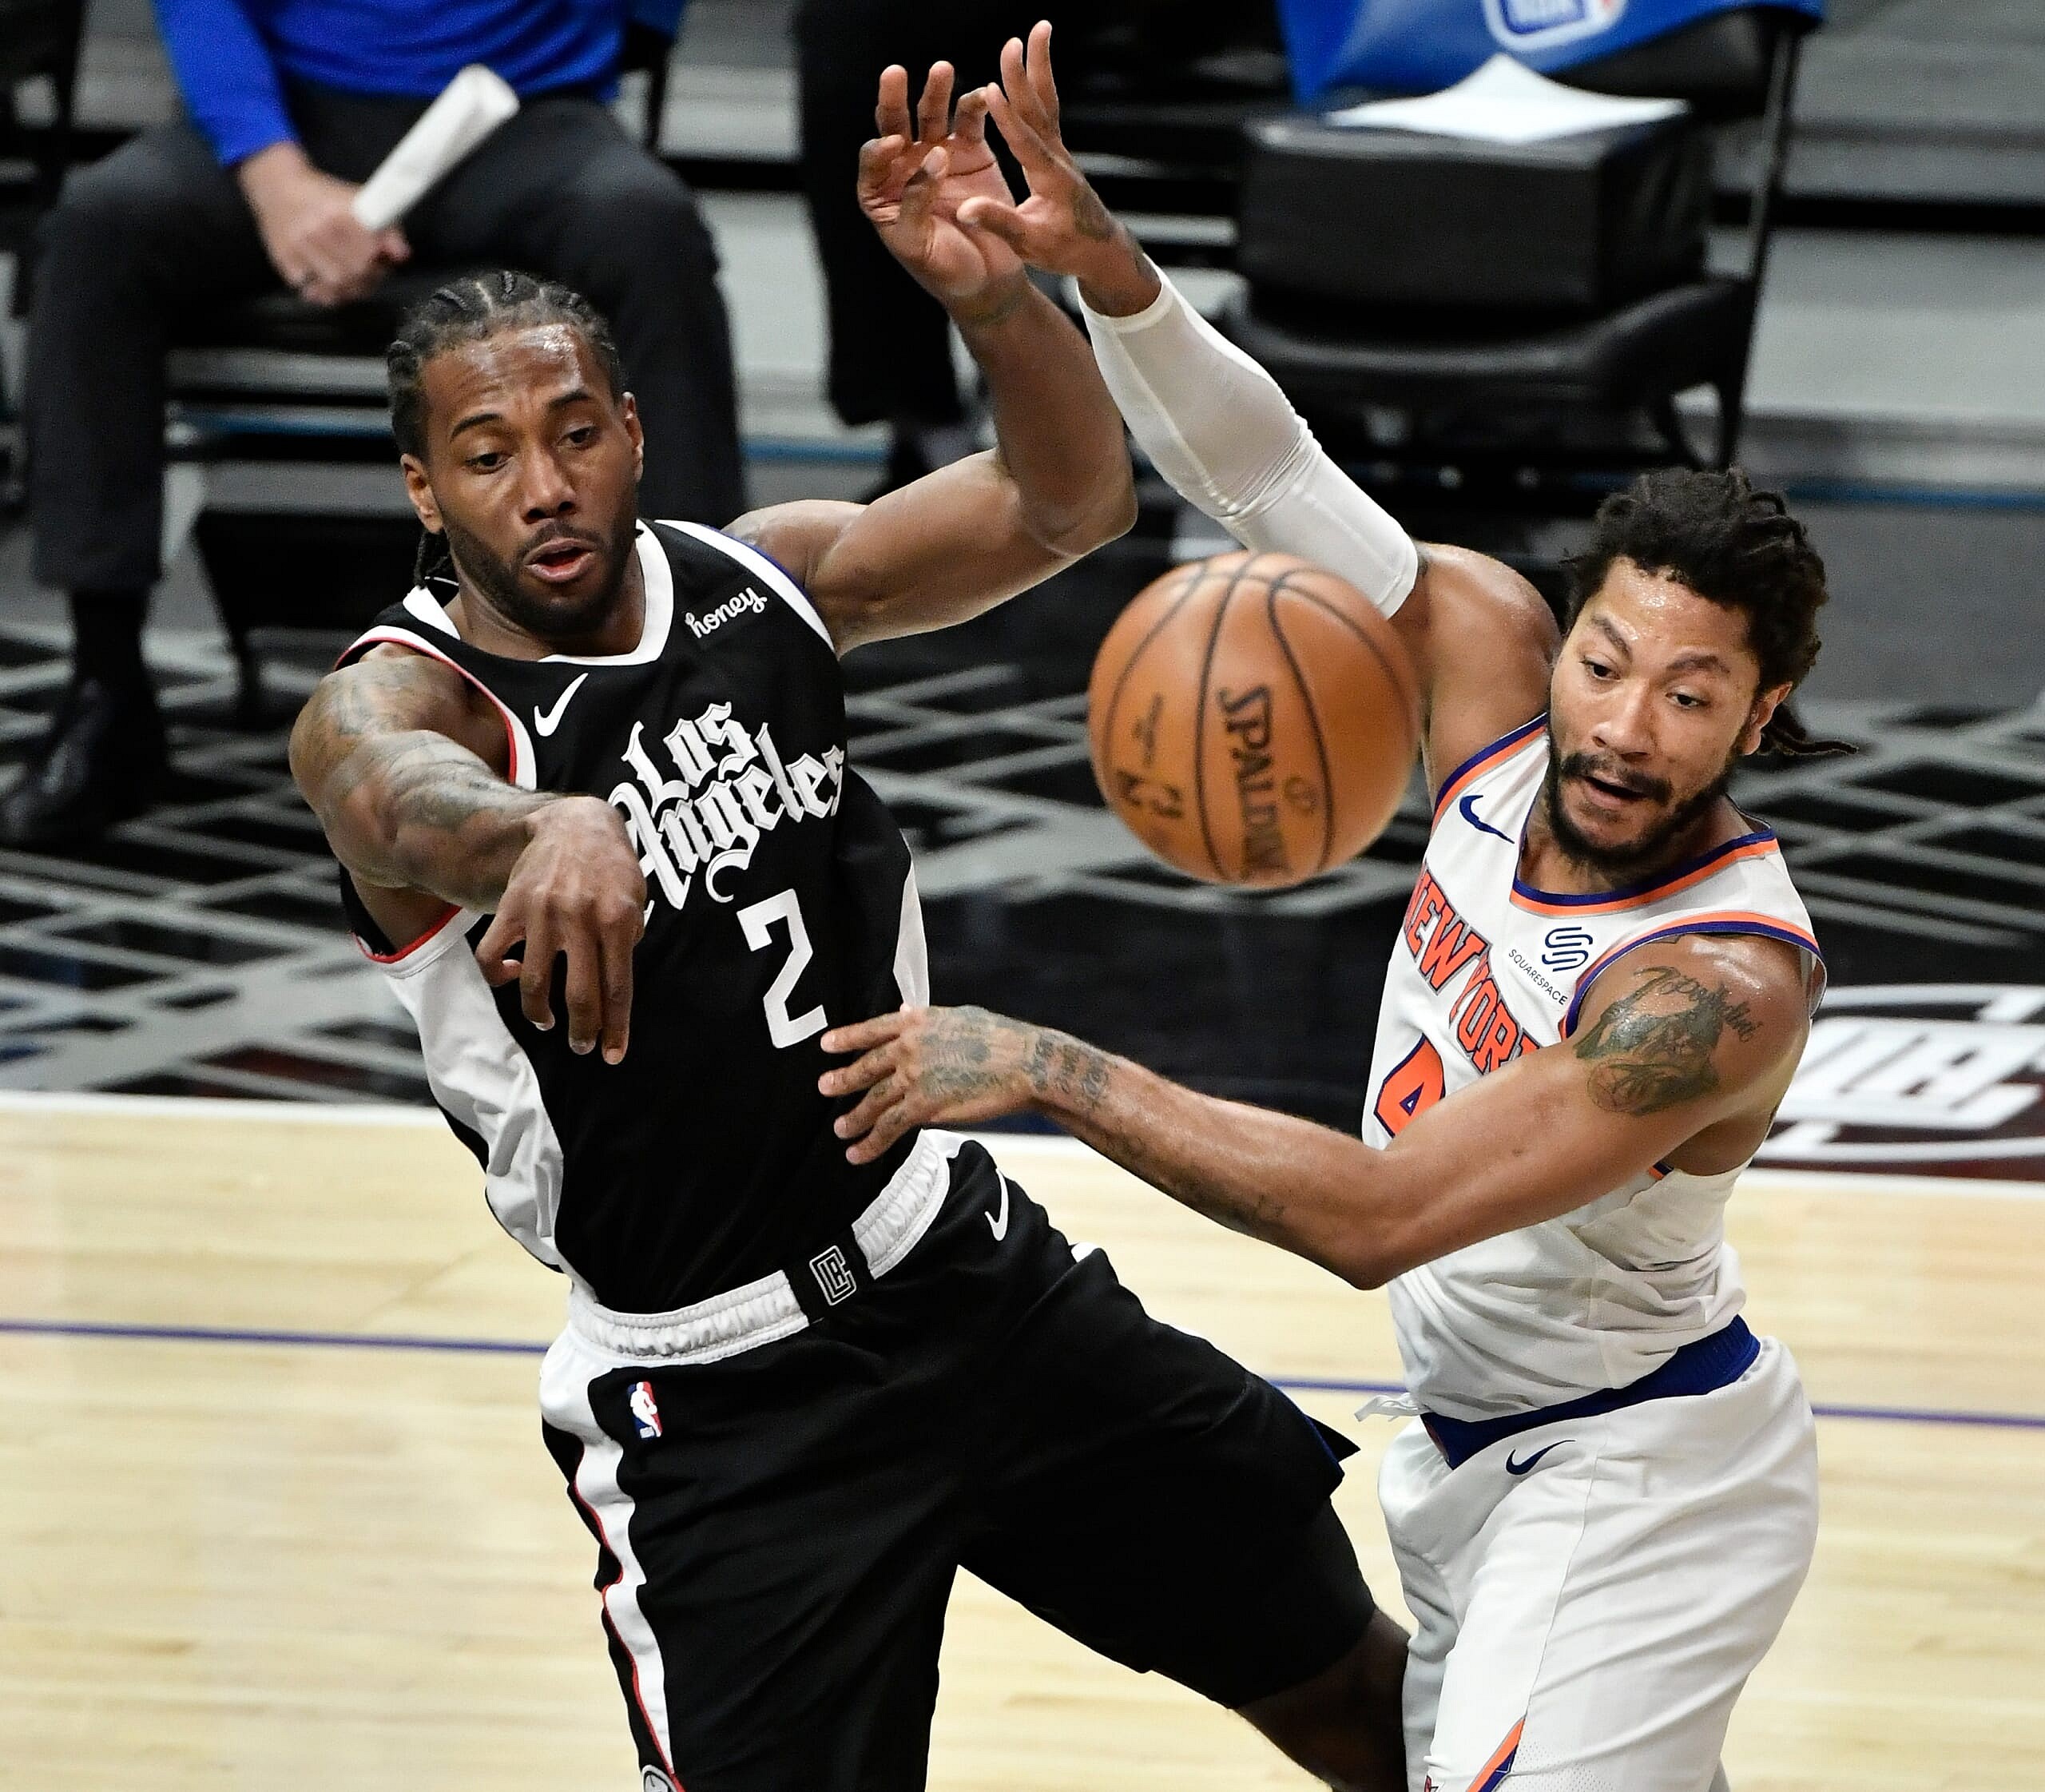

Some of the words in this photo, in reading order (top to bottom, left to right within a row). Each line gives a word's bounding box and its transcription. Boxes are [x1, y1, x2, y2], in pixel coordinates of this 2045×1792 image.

[685, 586, 768, 638] honey
[621, 701, 759, 816] Los
[737, 888, 828, 1049] 2
[1508, 948, 1568, 1006] SQUARESPACE
